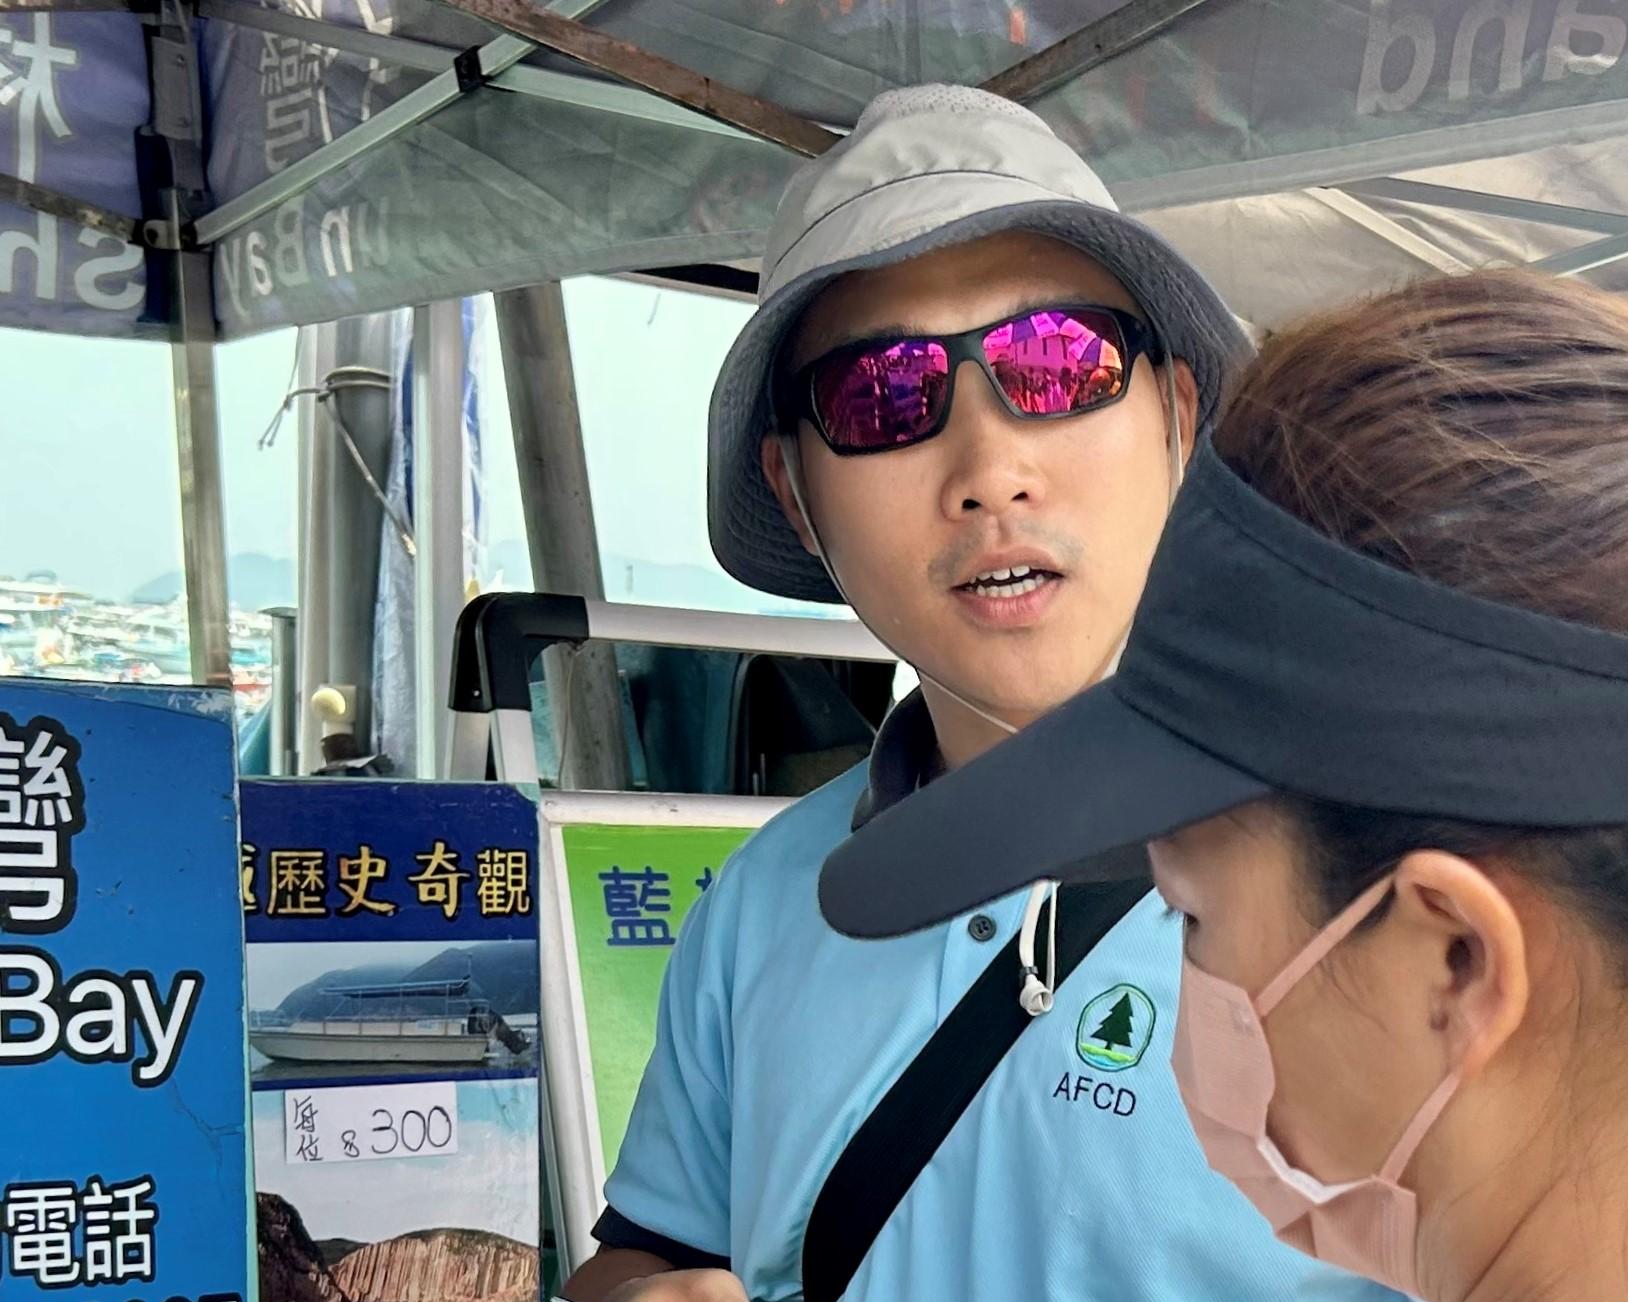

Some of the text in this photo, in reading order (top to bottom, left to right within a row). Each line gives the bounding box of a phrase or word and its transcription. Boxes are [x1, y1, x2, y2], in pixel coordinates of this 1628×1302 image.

[0, 953, 197, 1080] Bay
[1052, 1071, 1137, 1117] AFCD
[7, 1181, 154, 1284] 電話
